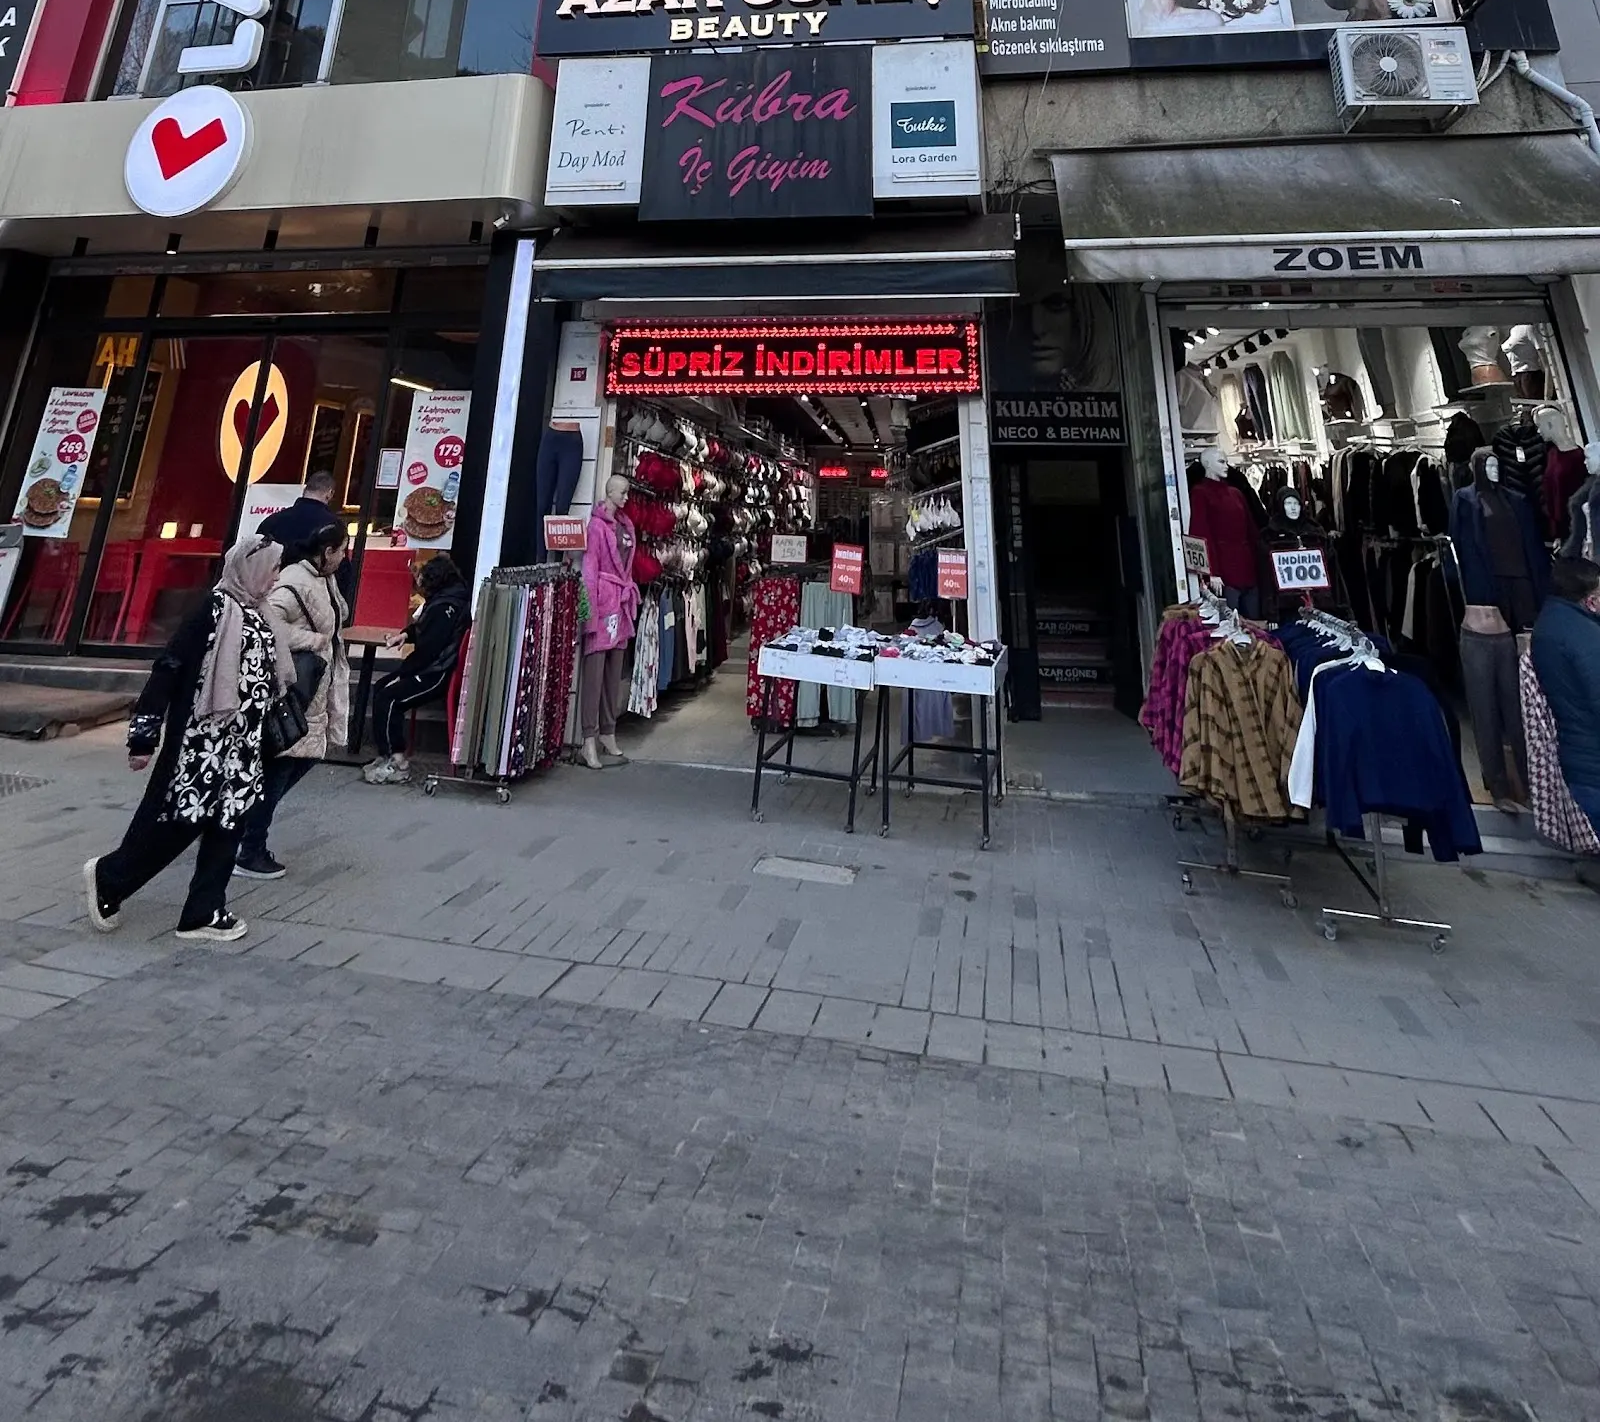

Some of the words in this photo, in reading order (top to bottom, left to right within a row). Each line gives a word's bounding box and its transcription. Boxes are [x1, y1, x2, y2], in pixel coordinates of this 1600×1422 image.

[669, 10, 828, 42] BEAUTY
[991, 17, 1017, 32] Akne
[1020, 16, 1056, 31] bakımı
[991, 39, 1037, 56] Gözenek
[1040, 37, 1104, 56] sıkılaştırma
[660, 70, 858, 130] Kübra
[565, 119, 625, 137] Penti
[896, 116, 947, 133] Tutku
[557, 151, 589, 173] Day
[592, 150, 626, 167] Mod
[679, 138, 712, 196] İç
[726, 144, 833, 196] Giyim
[892, 155, 915, 164] Lora
[919, 153, 957, 163] Garden
[1272, 244, 1424, 271] ZOEM
[620, 344, 744, 377] SÜPRİZ
[755, 343, 965, 376] İNDİRİMLER
[423, 406, 461, 414] Lahmacun
[995, 396, 1119, 418] KUAFÖRÜM
[422, 414, 444, 424] Ayran
[998, 426, 1038, 438] NECO
[1046, 426, 1056, 438] &
[1060, 427, 1120, 439] BEYHAN
[59, 441, 83, 454] 269
[438, 444, 462, 457] 179
[548, 522, 582, 535] İNDİRİM
[553, 535, 568, 545] 150
[1187, 550, 1205, 567] 150
[1278, 553, 1321, 565] İNDİRİM
[1283, 564, 1321, 581] 100
[1036, 622, 1056, 631] ZAR
